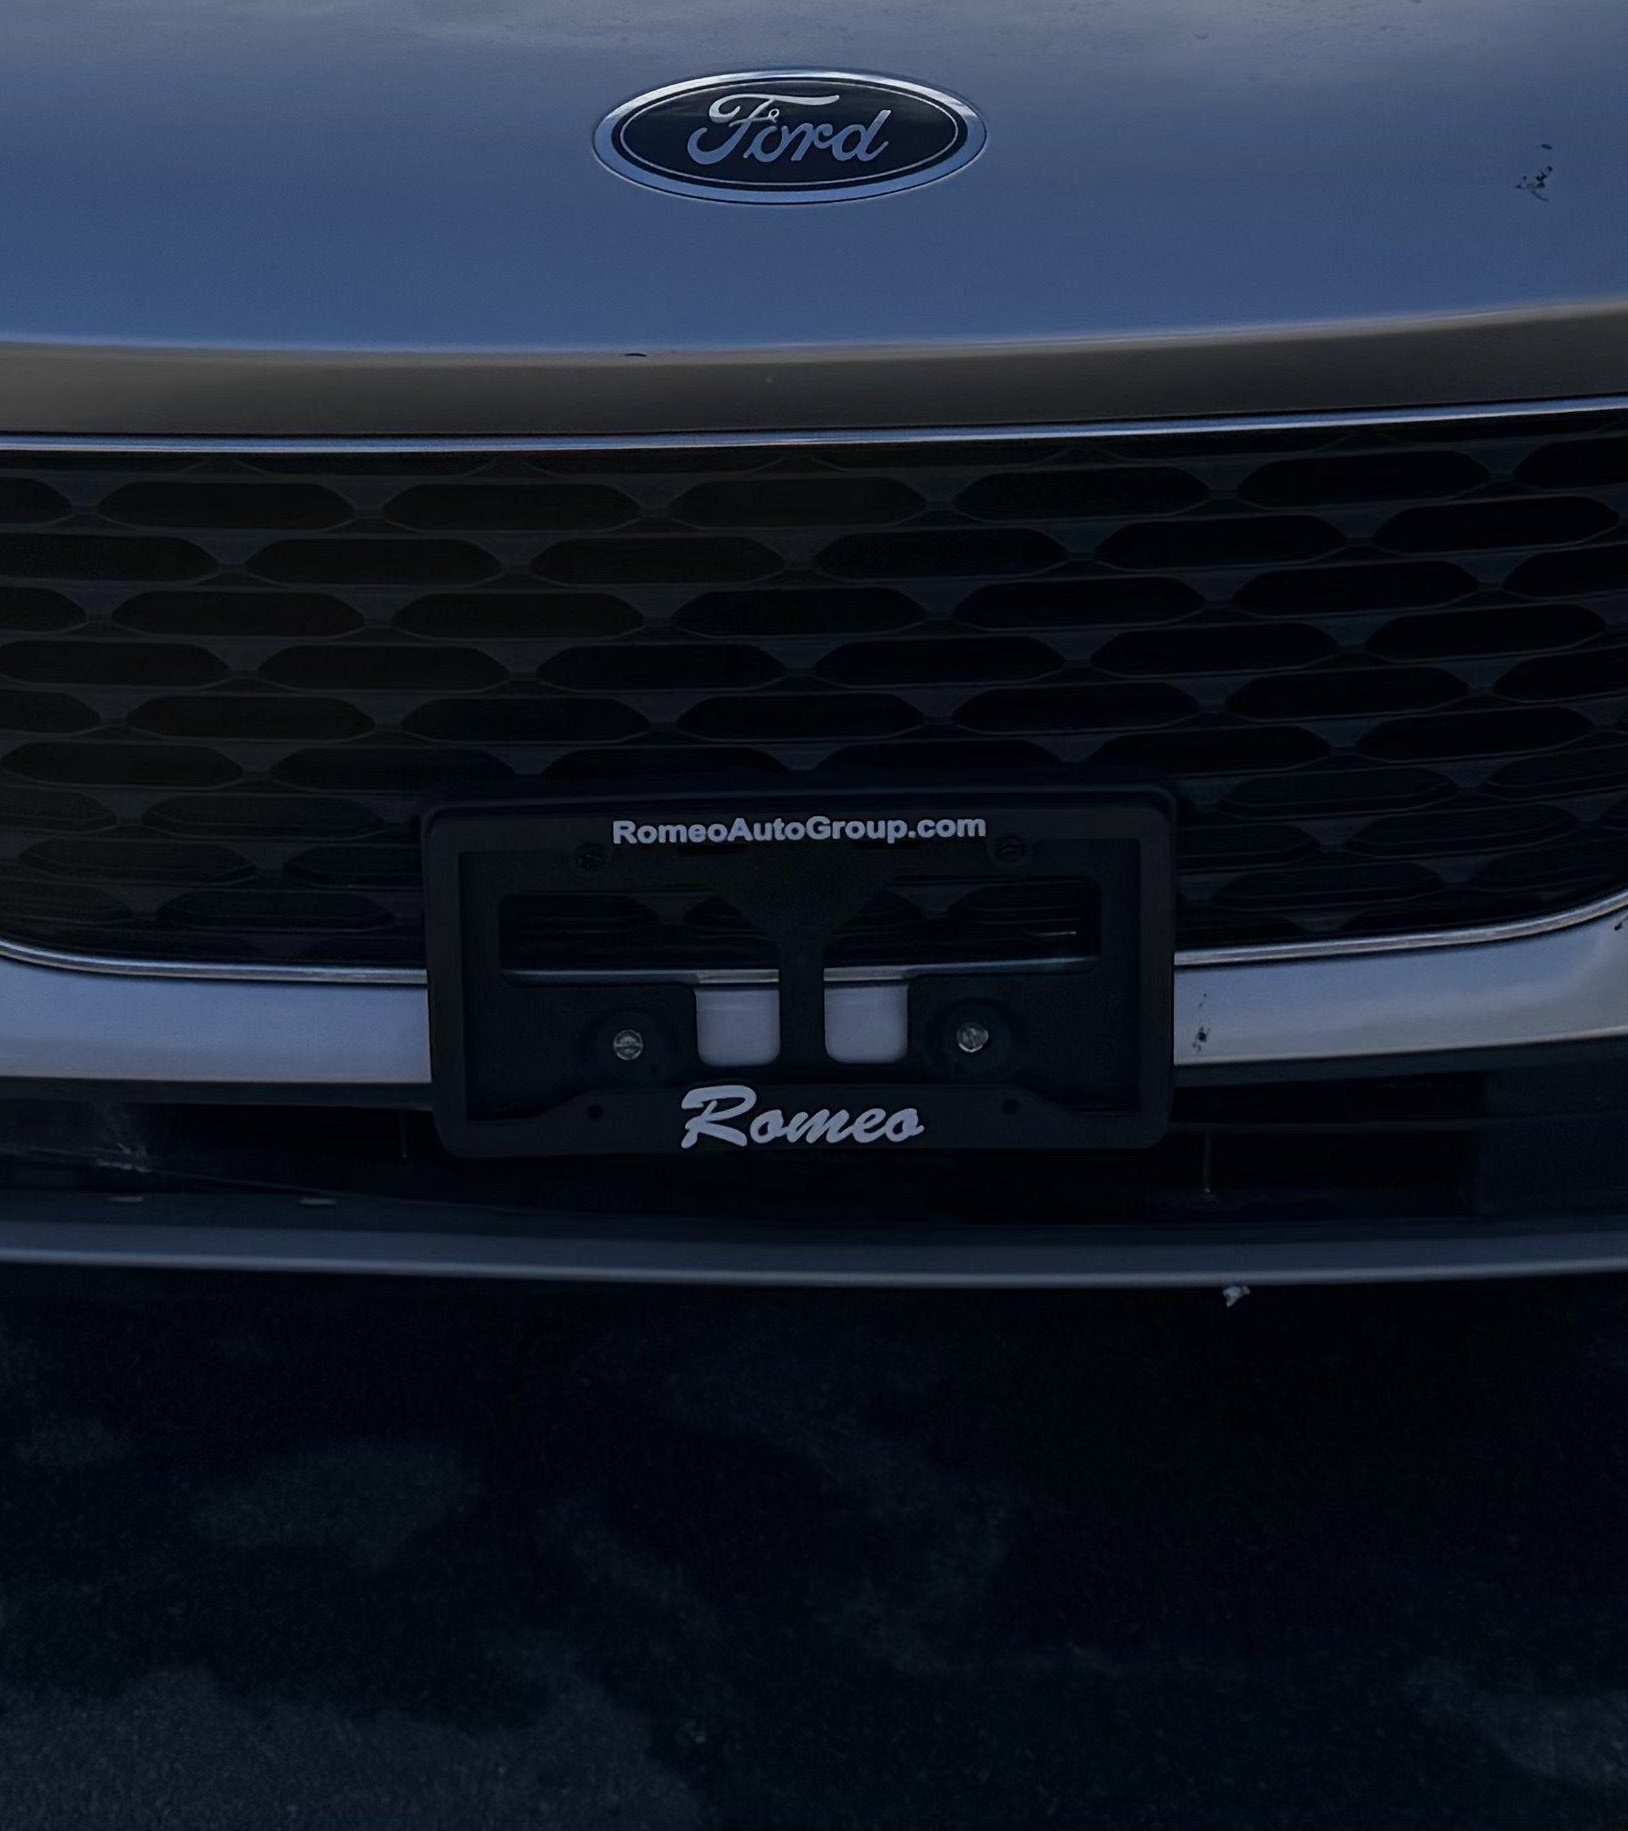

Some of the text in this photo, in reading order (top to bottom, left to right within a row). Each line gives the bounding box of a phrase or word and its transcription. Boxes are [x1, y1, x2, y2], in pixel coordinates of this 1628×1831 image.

[687, 93, 892, 165] Ford
[612, 815, 987, 845] RomeoAutoGroup.com
[680, 1084, 925, 1149] Romeo
